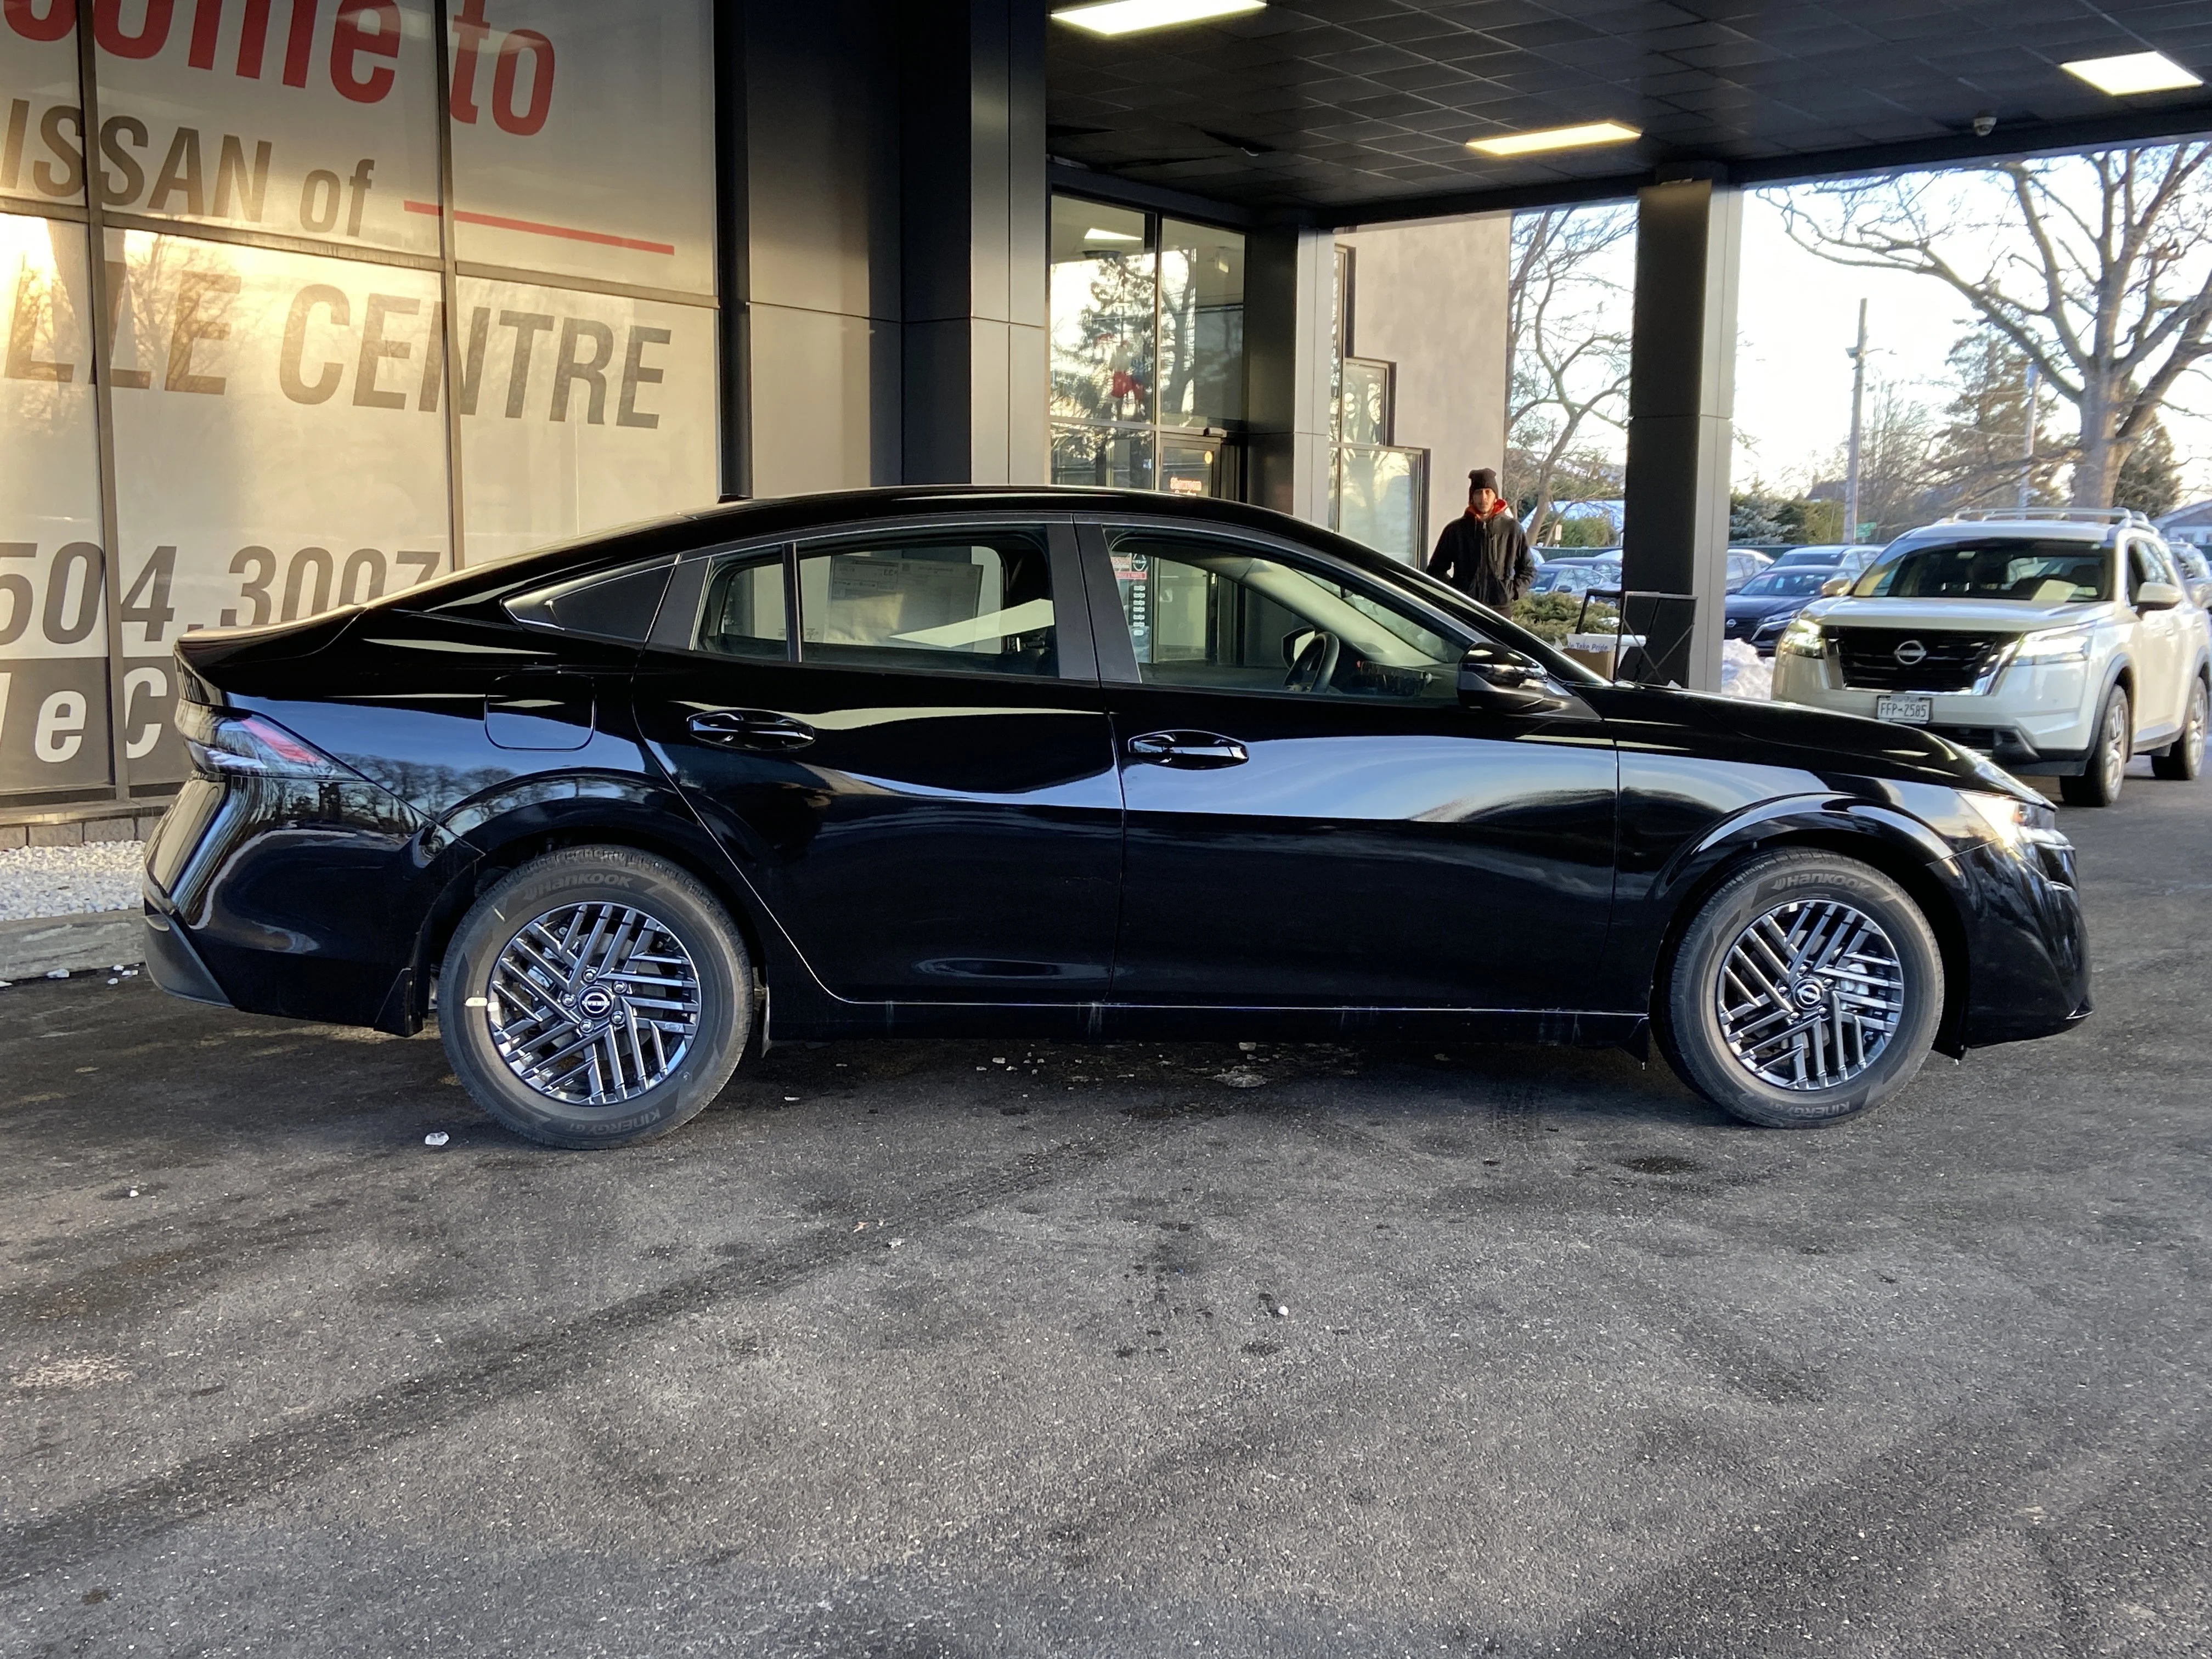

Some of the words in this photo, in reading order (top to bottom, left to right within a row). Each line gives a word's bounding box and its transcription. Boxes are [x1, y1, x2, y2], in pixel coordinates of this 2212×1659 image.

[450, 0, 555, 136] to
[300, 159, 375, 237] of
[279, 283, 672, 430] CENTRE
